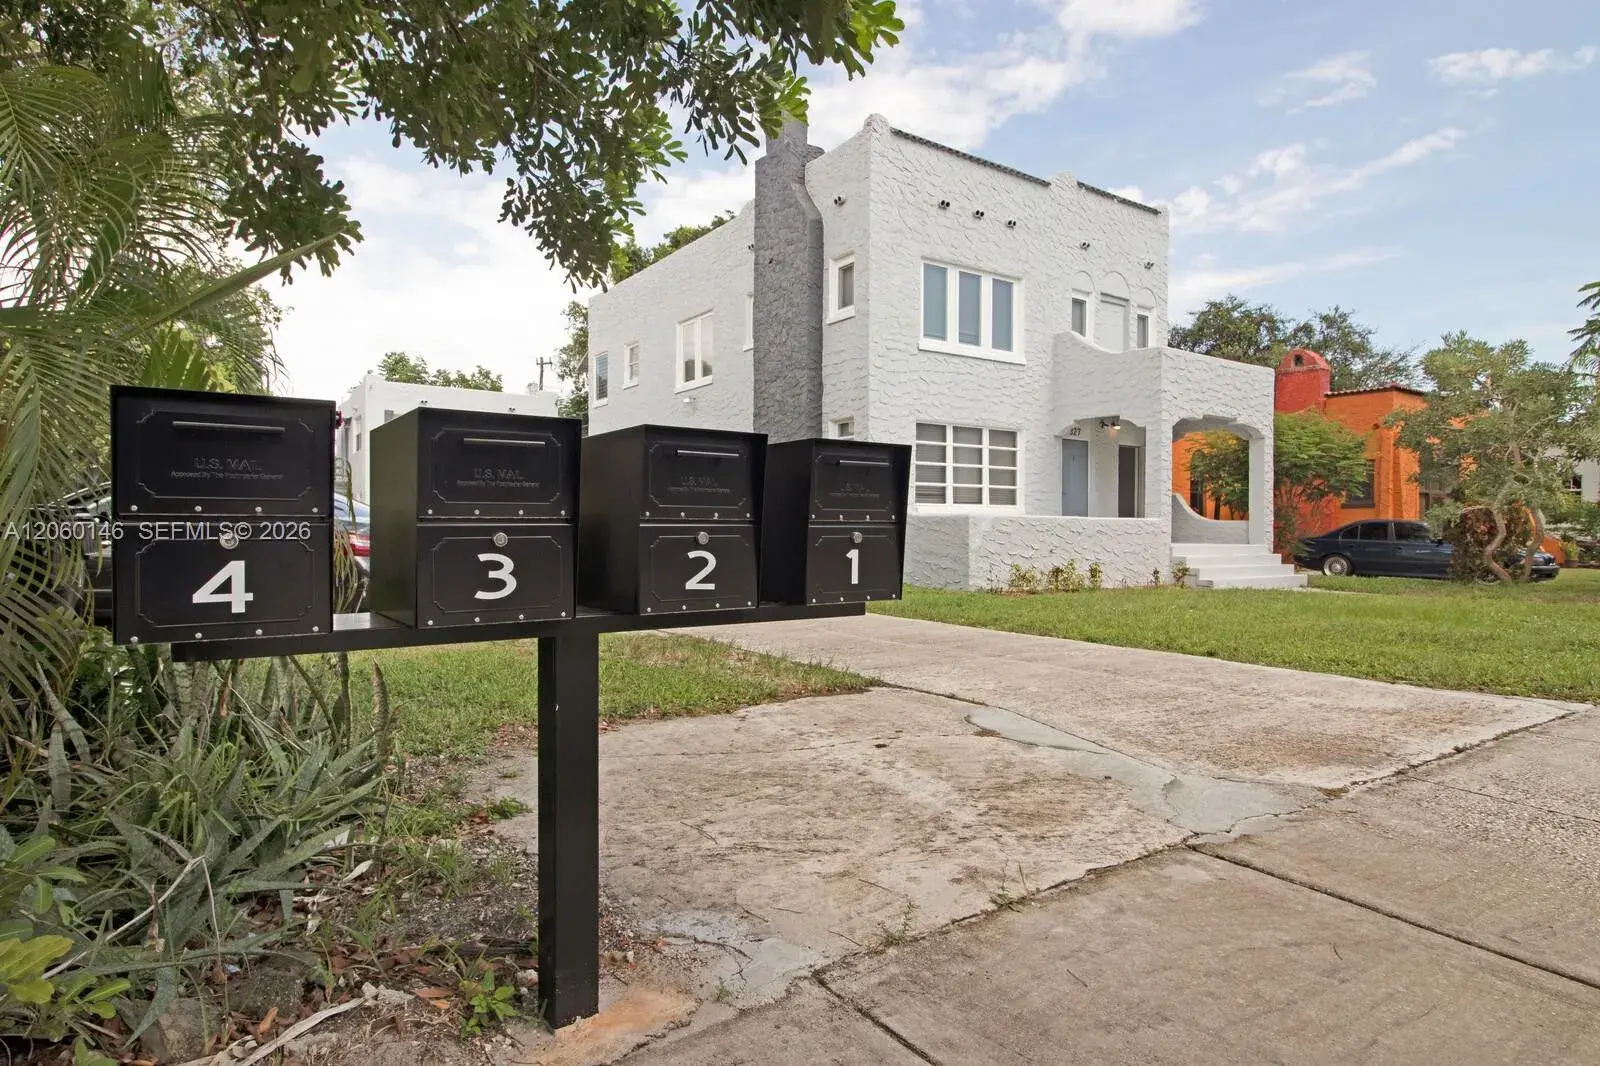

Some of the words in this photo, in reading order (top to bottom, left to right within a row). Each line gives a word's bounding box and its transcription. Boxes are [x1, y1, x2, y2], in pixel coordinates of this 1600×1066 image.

[193, 560, 253, 613] 4
[475, 553, 516, 599] 3
[686, 551, 716, 589] 2
[846, 549, 858, 584] 1
